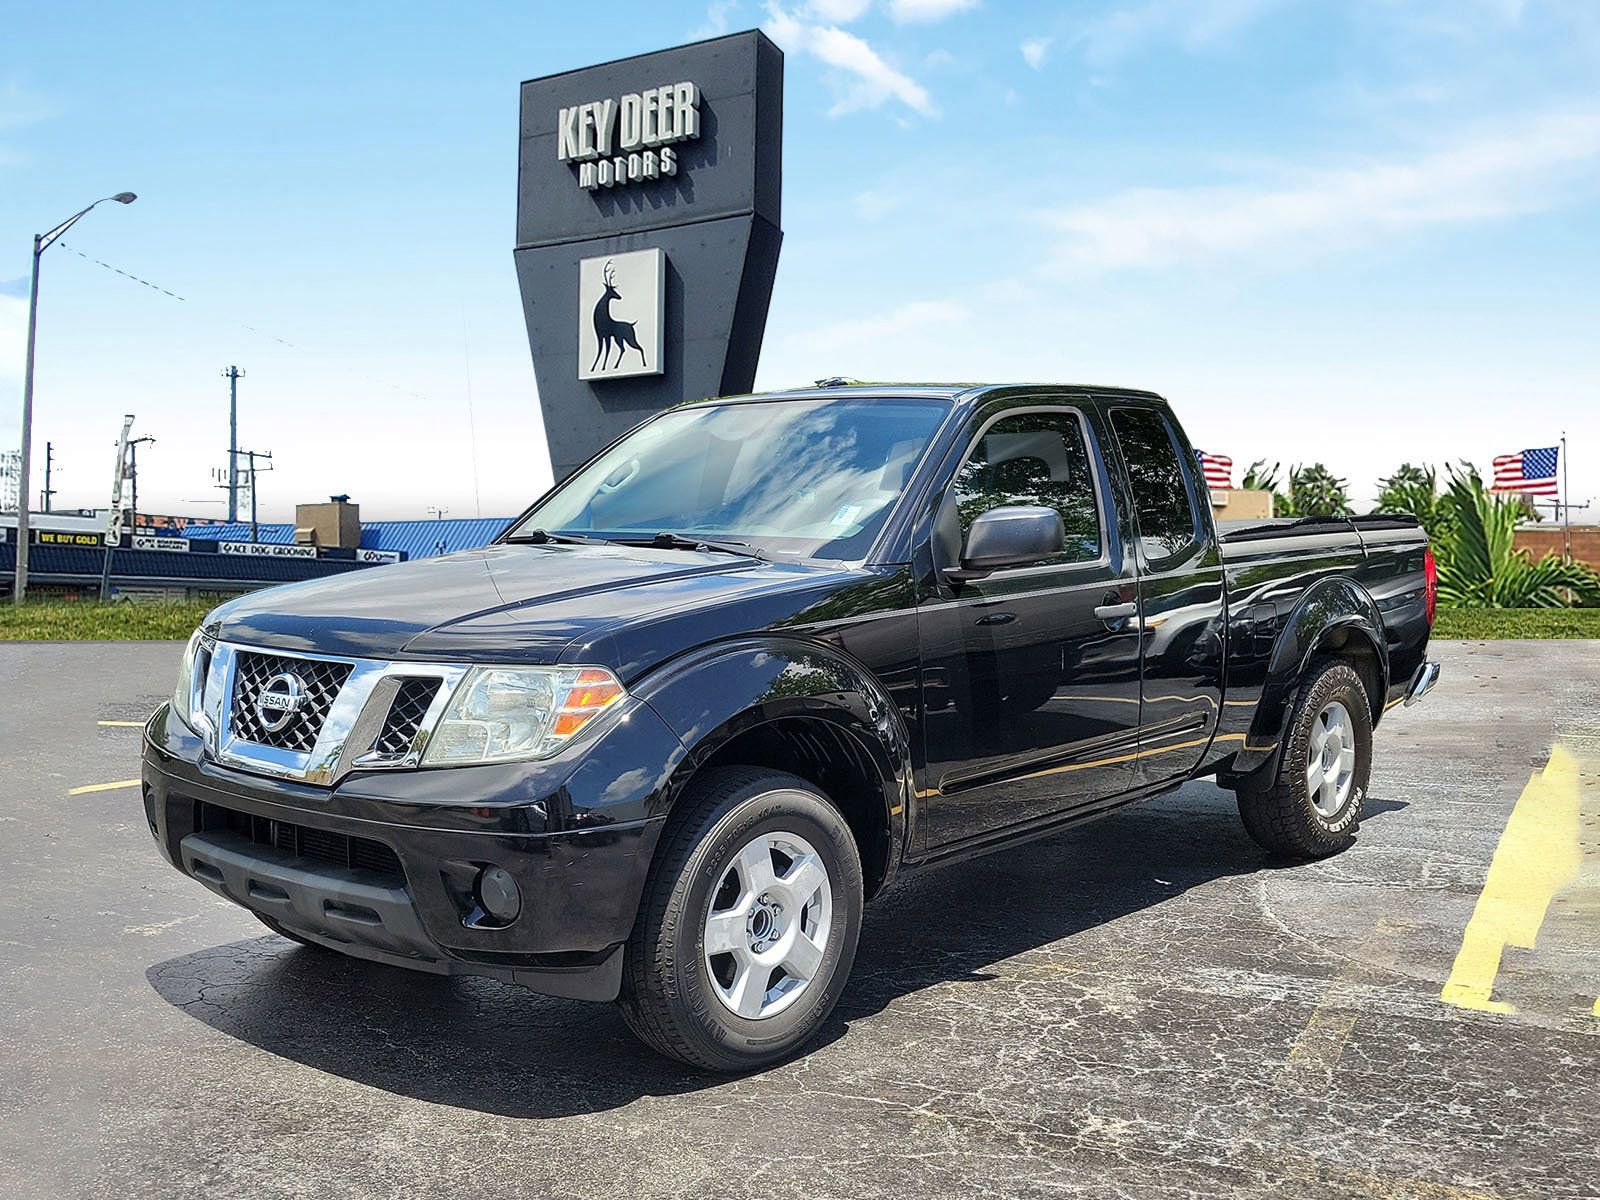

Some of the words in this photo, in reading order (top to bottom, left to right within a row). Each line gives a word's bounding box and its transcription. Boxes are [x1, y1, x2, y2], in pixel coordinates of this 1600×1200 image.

[558, 98, 617, 162] KEY
[620, 81, 700, 152] DEER
[579, 147, 677, 190] MOTORS
[41, 532, 55, 543] WE
[57, 533, 75, 544] BUY
[76, 535, 98, 545] GOLD
[232, 545, 247, 554] ACE
[251, 546, 270, 555] DOG
[273, 547, 315, 557] GROOMING
[259, 694, 290, 708] SSAN
